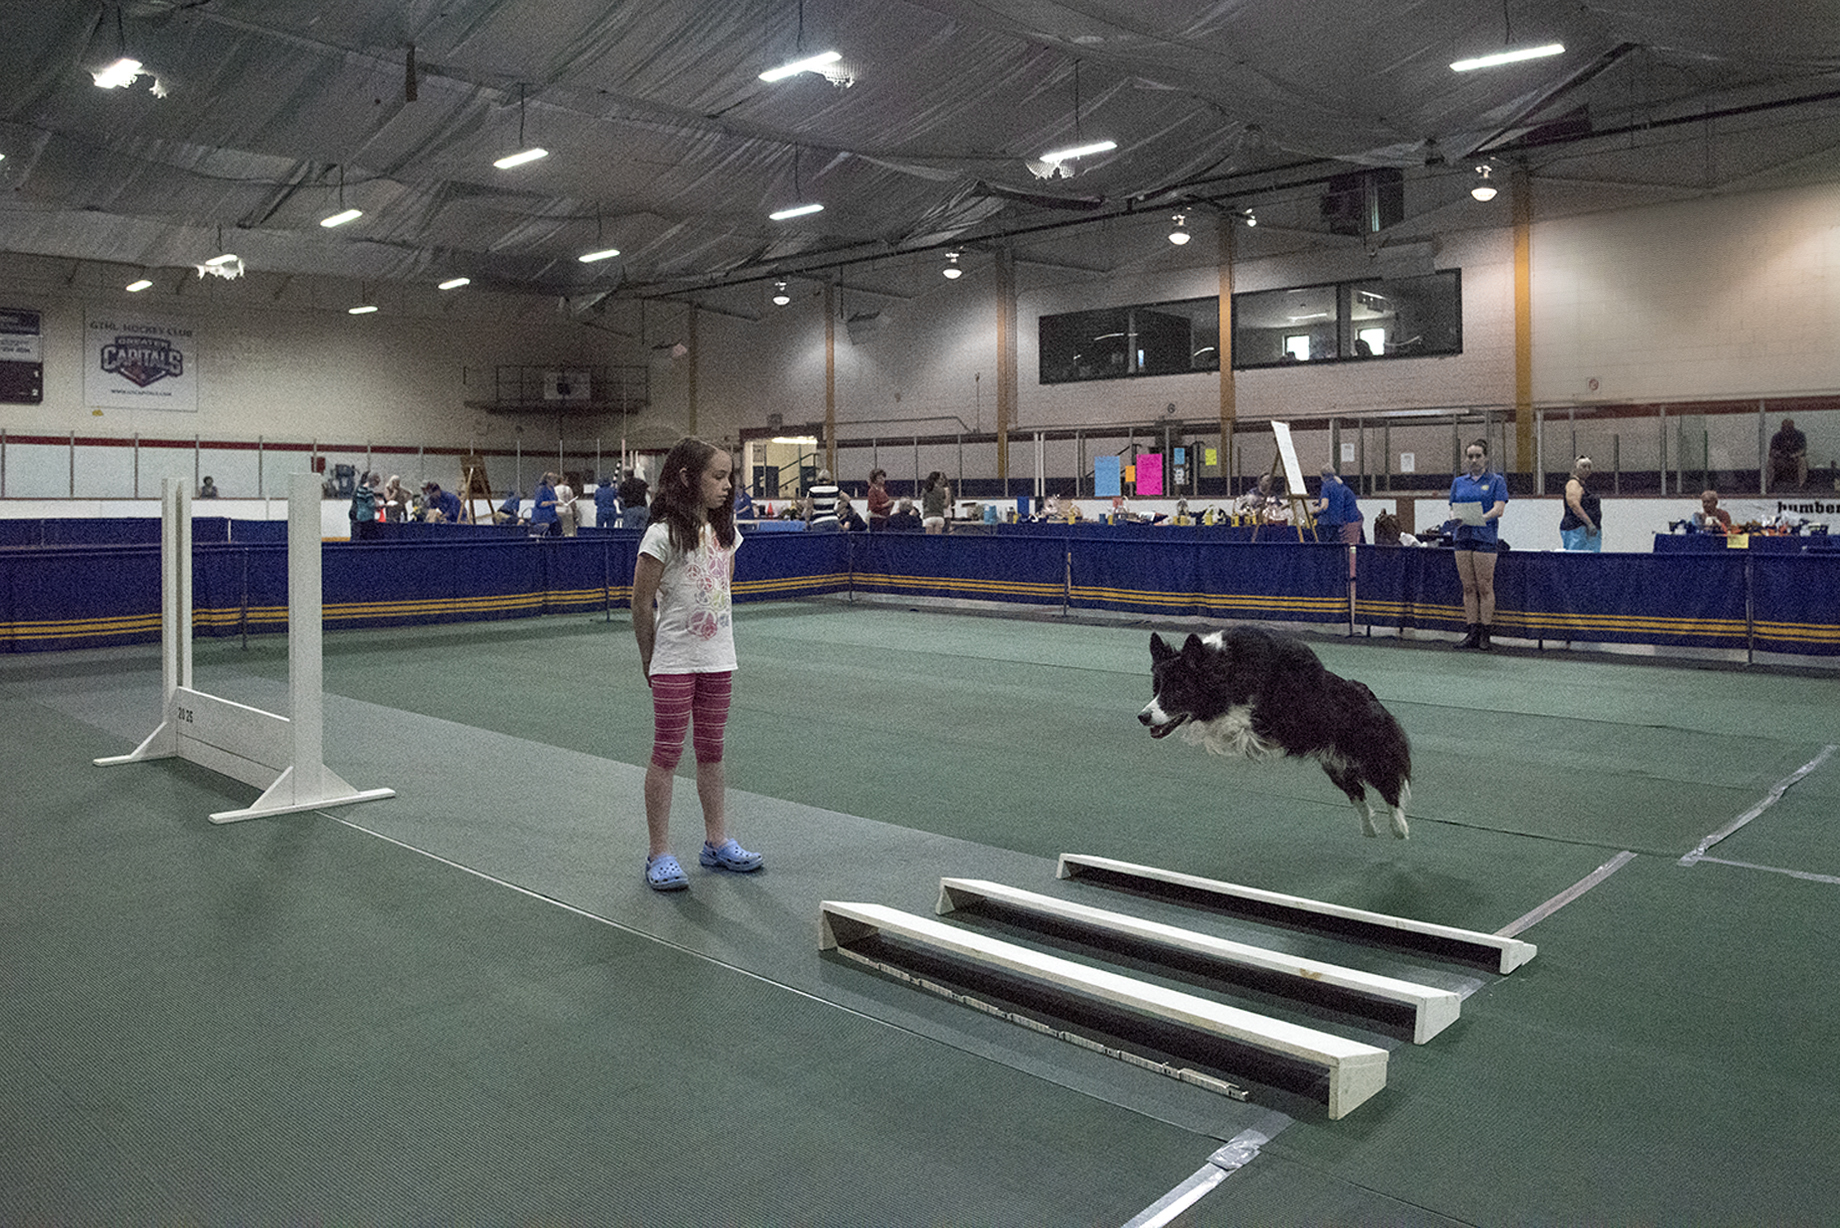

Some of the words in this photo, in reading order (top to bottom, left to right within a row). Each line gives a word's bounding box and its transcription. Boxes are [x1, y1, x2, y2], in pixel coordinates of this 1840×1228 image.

[123, 323, 164, 335] HOCKEY
[167, 328, 193, 338] CLUB
[118, 338, 168, 348] GREATER
[103, 346, 181, 375] CAPITALS
[1167, 403, 1176, 414] 6
